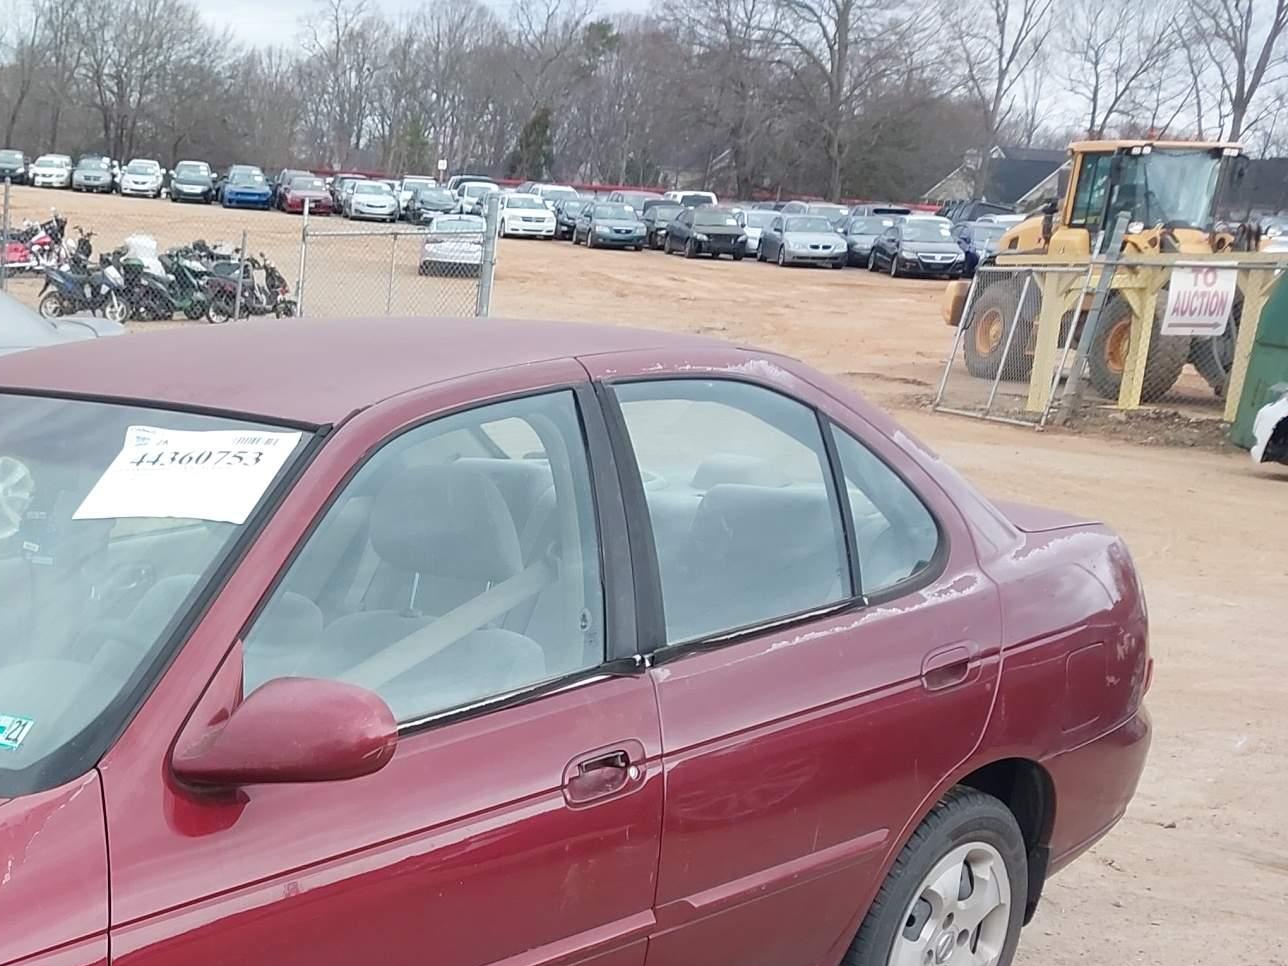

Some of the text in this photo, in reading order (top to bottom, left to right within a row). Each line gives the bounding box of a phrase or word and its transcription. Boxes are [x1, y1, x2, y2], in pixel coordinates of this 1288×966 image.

[1191, 266, 1218, 287] TO
[1171, 289, 1229, 316] AUCTION
[130, 450, 263, 467] 44360753
[5, 720, 28, 742] 21
